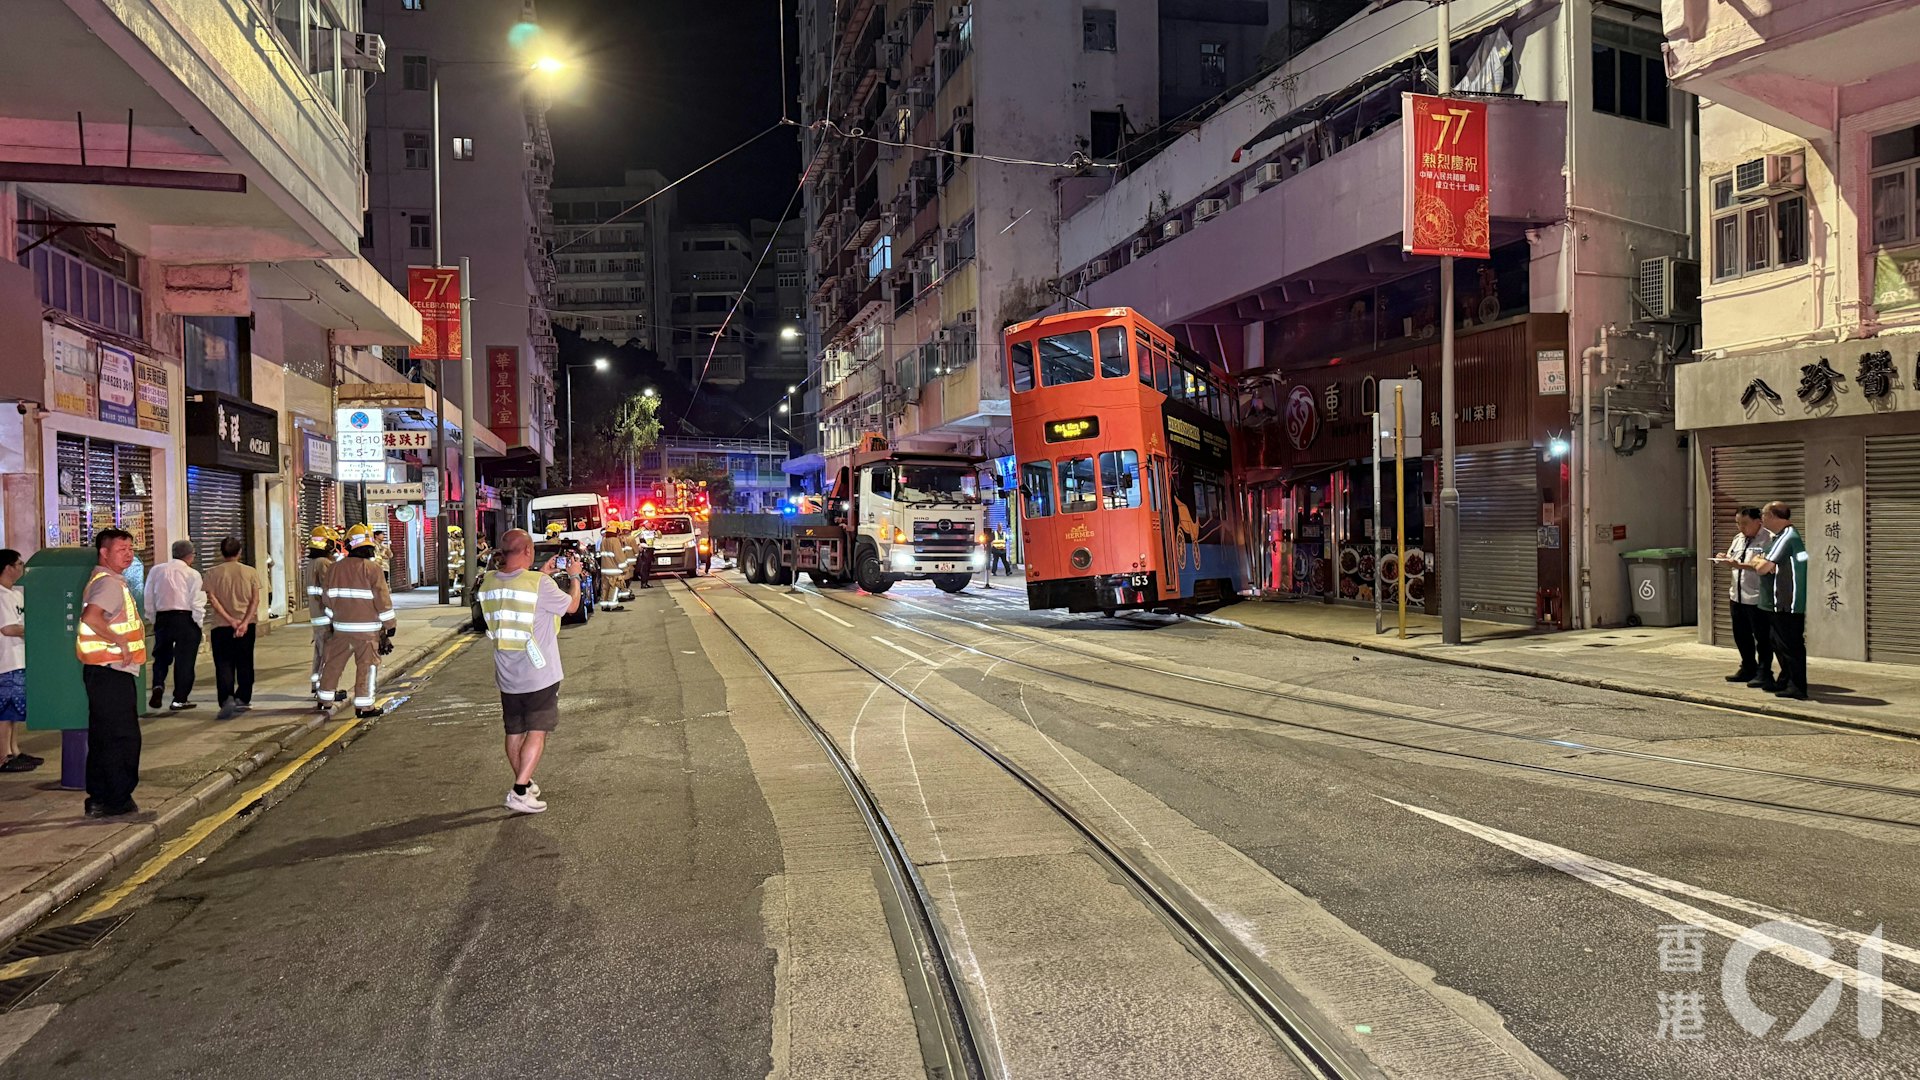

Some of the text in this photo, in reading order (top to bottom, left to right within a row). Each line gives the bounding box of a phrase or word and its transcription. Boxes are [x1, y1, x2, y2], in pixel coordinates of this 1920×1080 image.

[1431, 108, 1475, 152] 77
[1422, 152, 1478, 173] 熱烈慶祝
[1419, 170, 1467, 182] 中華人民共和國
[1435, 182, 1482, 192] 成立七十七周年
[422, 273, 455, 300] 77
[1110, 307, 1127, 317] 153
[495, 352, 512, 424] 華星冰室
[217, 404, 241, 452] 海洋
[249, 438, 271, 455] OCEAN
[355, 435, 380, 444] 8-10
[356, 448, 377, 457] 5-7
[1824, 454, 1844, 613] 八珍甜醋份外香
[1131, 575, 1149, 586] 153
